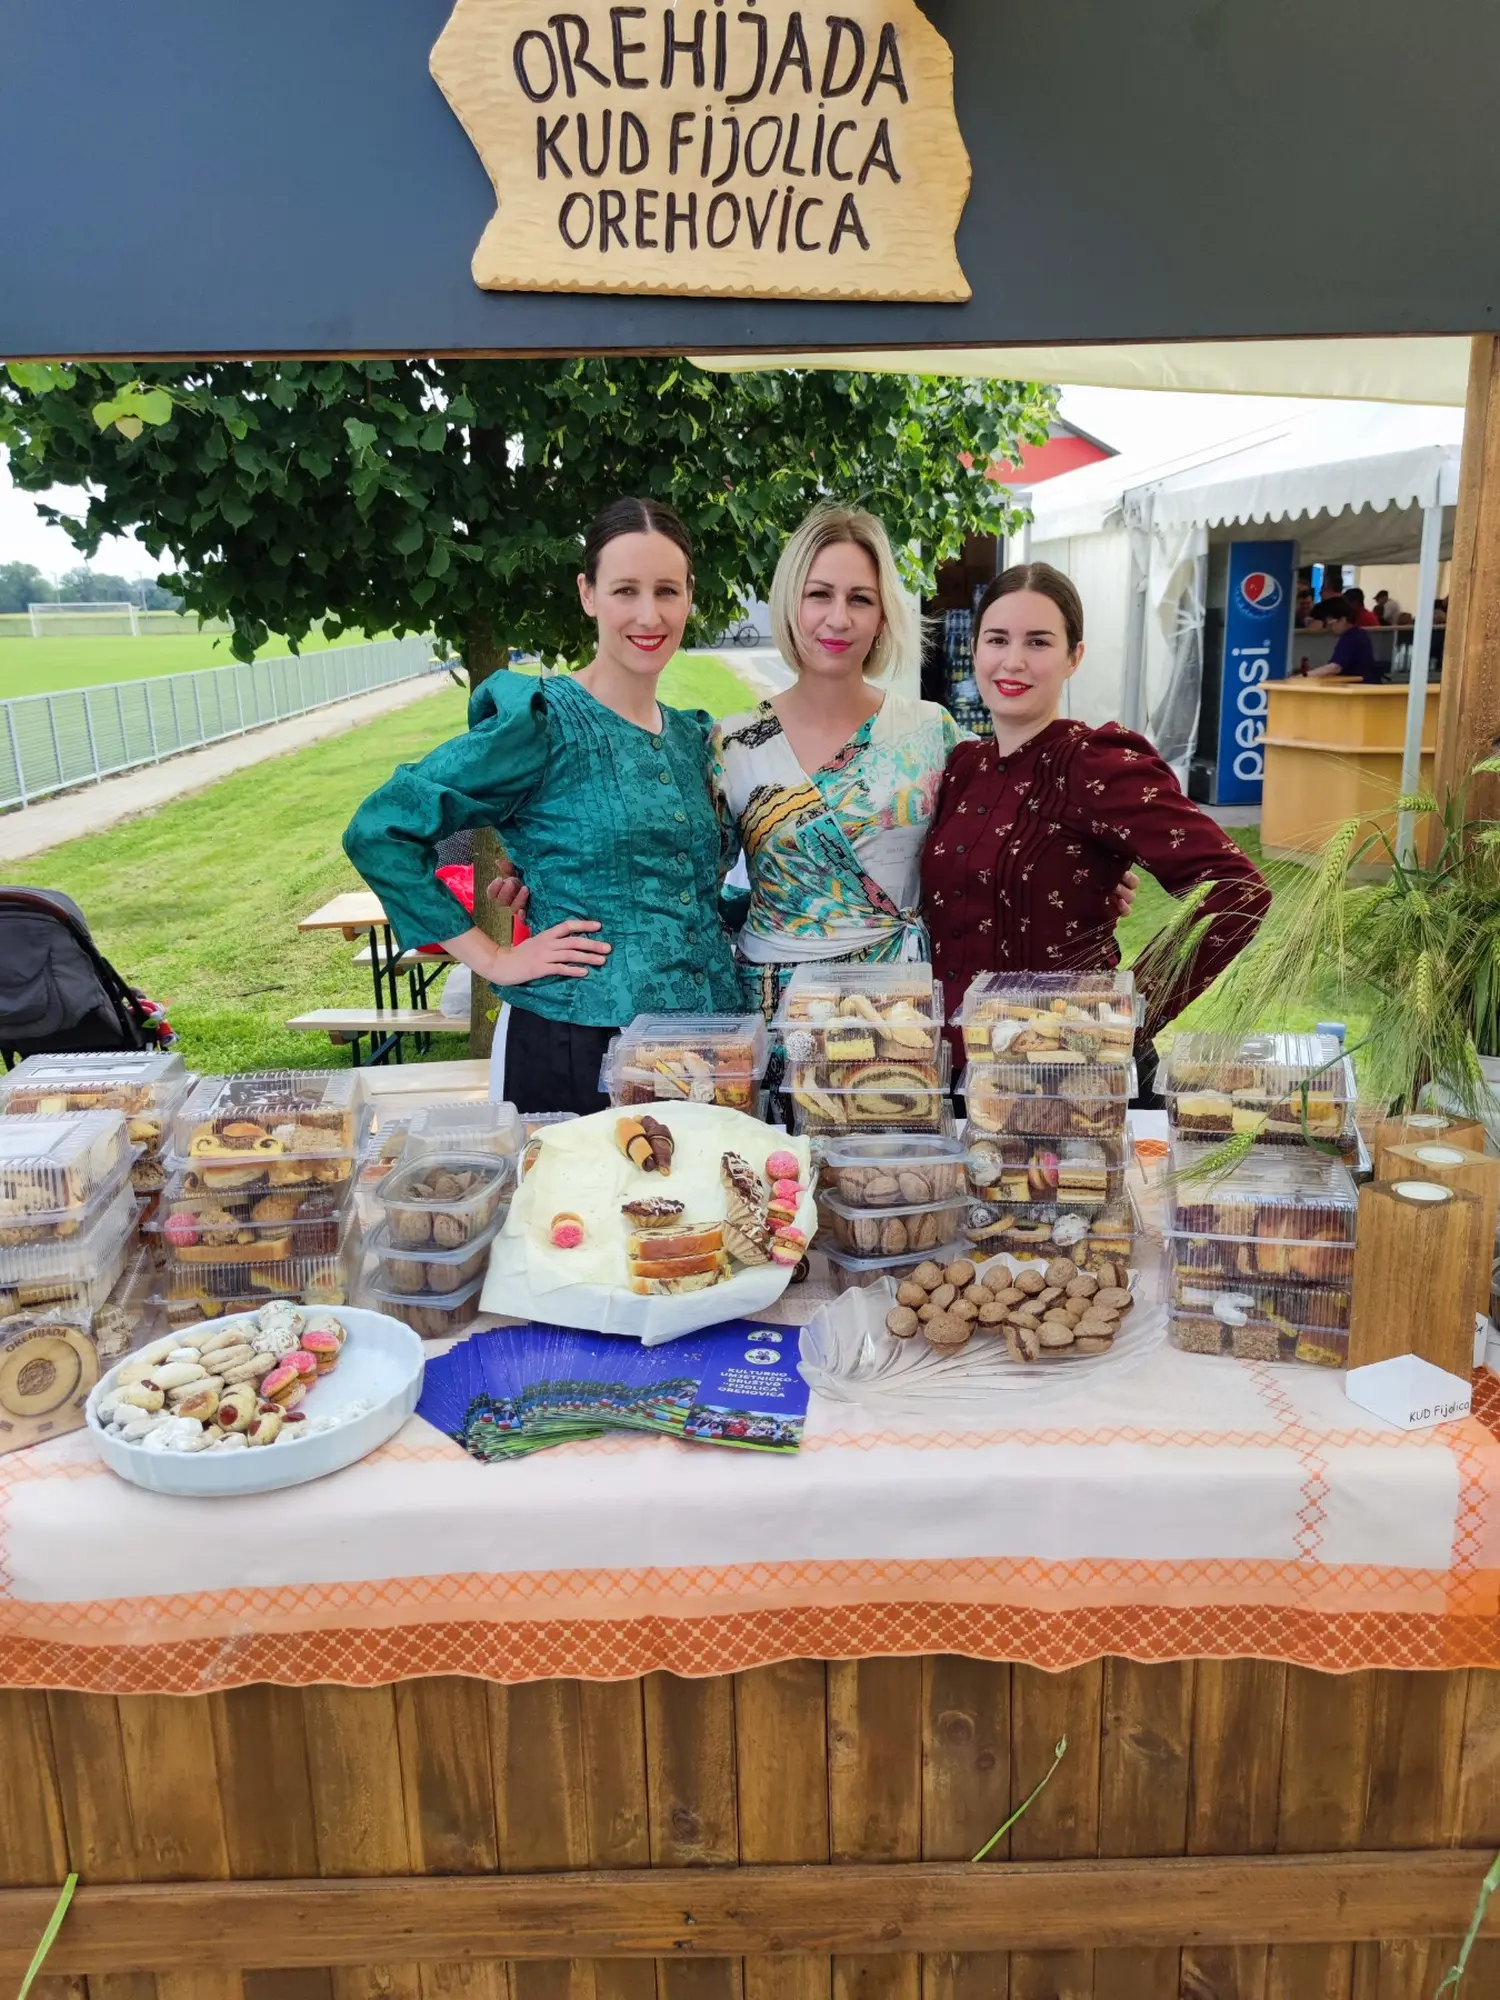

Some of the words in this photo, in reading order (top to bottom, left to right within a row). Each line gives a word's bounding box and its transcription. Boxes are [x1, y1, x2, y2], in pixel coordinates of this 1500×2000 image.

[512, 0, 908, 105] OREHIJADA
[537, 108, 649, 180] KUD
[669, 102, 902, 188] FIJOLICA
[558, 185, 870, 254] OREHOVICA
[1231, 647, 1271, 781] pepsi
[717, 1386, 785, 1398] OREHOVICA
[727, 1367, 788, 1377] KULTURNO
[728, 1377, 781, 1387] DRUŠTVO
[1409, 1408, 1431, 1423] KUD
[1433, 1401, 1470, 1418] Fijolica
